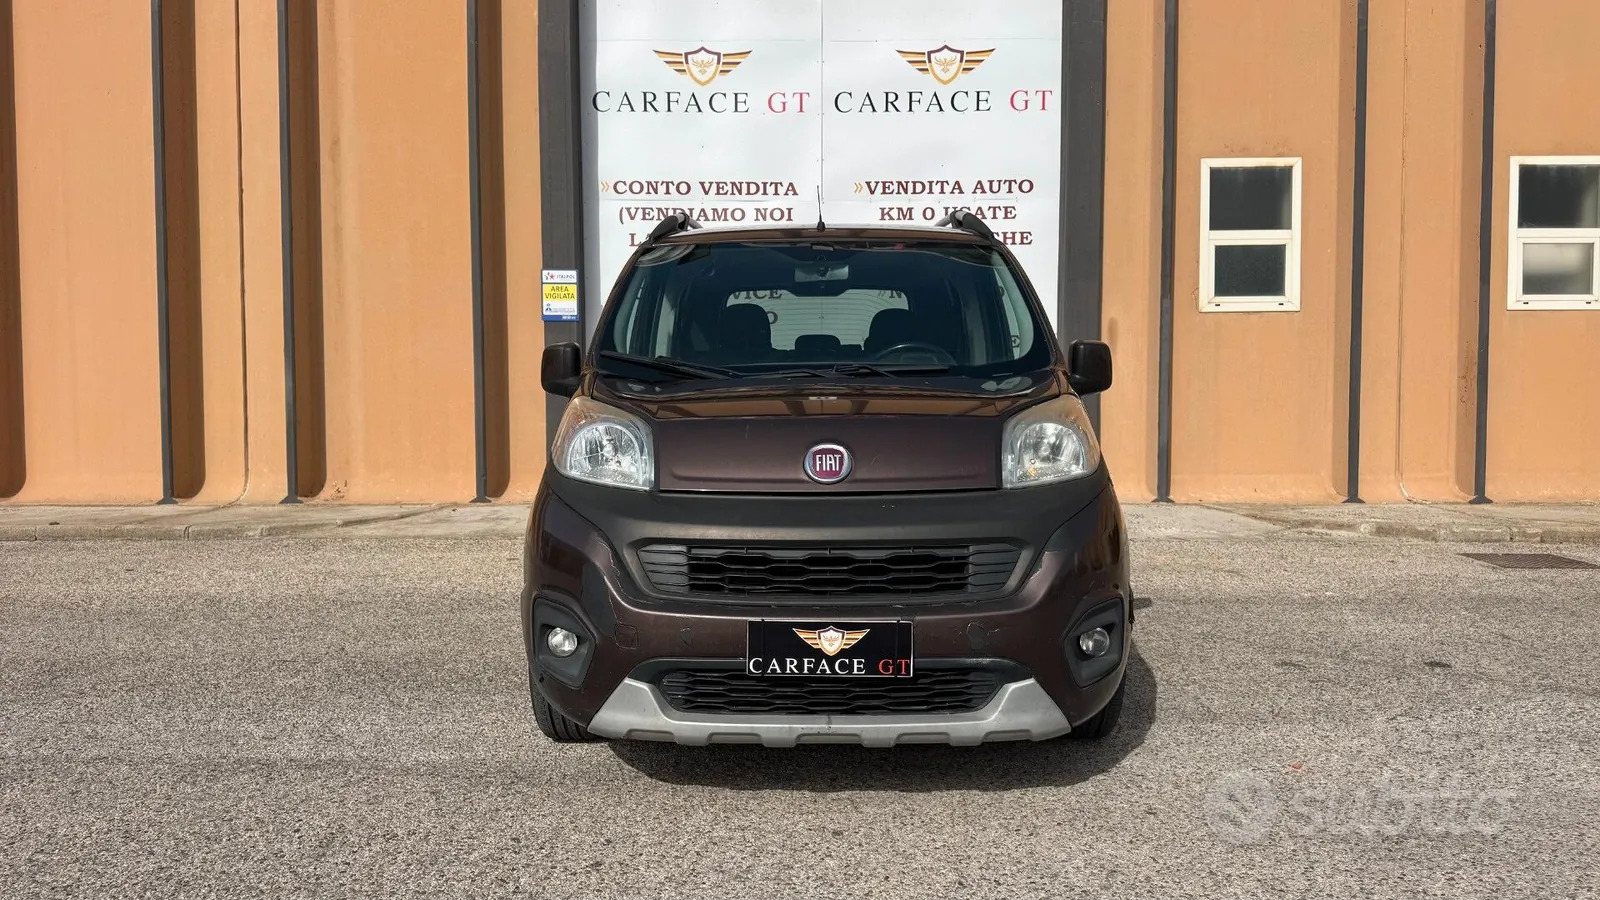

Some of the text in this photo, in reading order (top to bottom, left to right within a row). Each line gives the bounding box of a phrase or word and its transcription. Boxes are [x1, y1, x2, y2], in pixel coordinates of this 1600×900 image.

[591, 90, 810, 113] CARFACE GT
[834, 90, 1053, 114] CARFACE GT
[612, 180, 799, 196] CONTO VENDITA
[864, 179, 1034, 195] VENDITA AUTO
[754, 207, 794, 222] NOI
[879, 206, 915, 221] KM
[815, 454, 842, 472] FIAT
[749, 657, 911, 676] CARFACE GT
